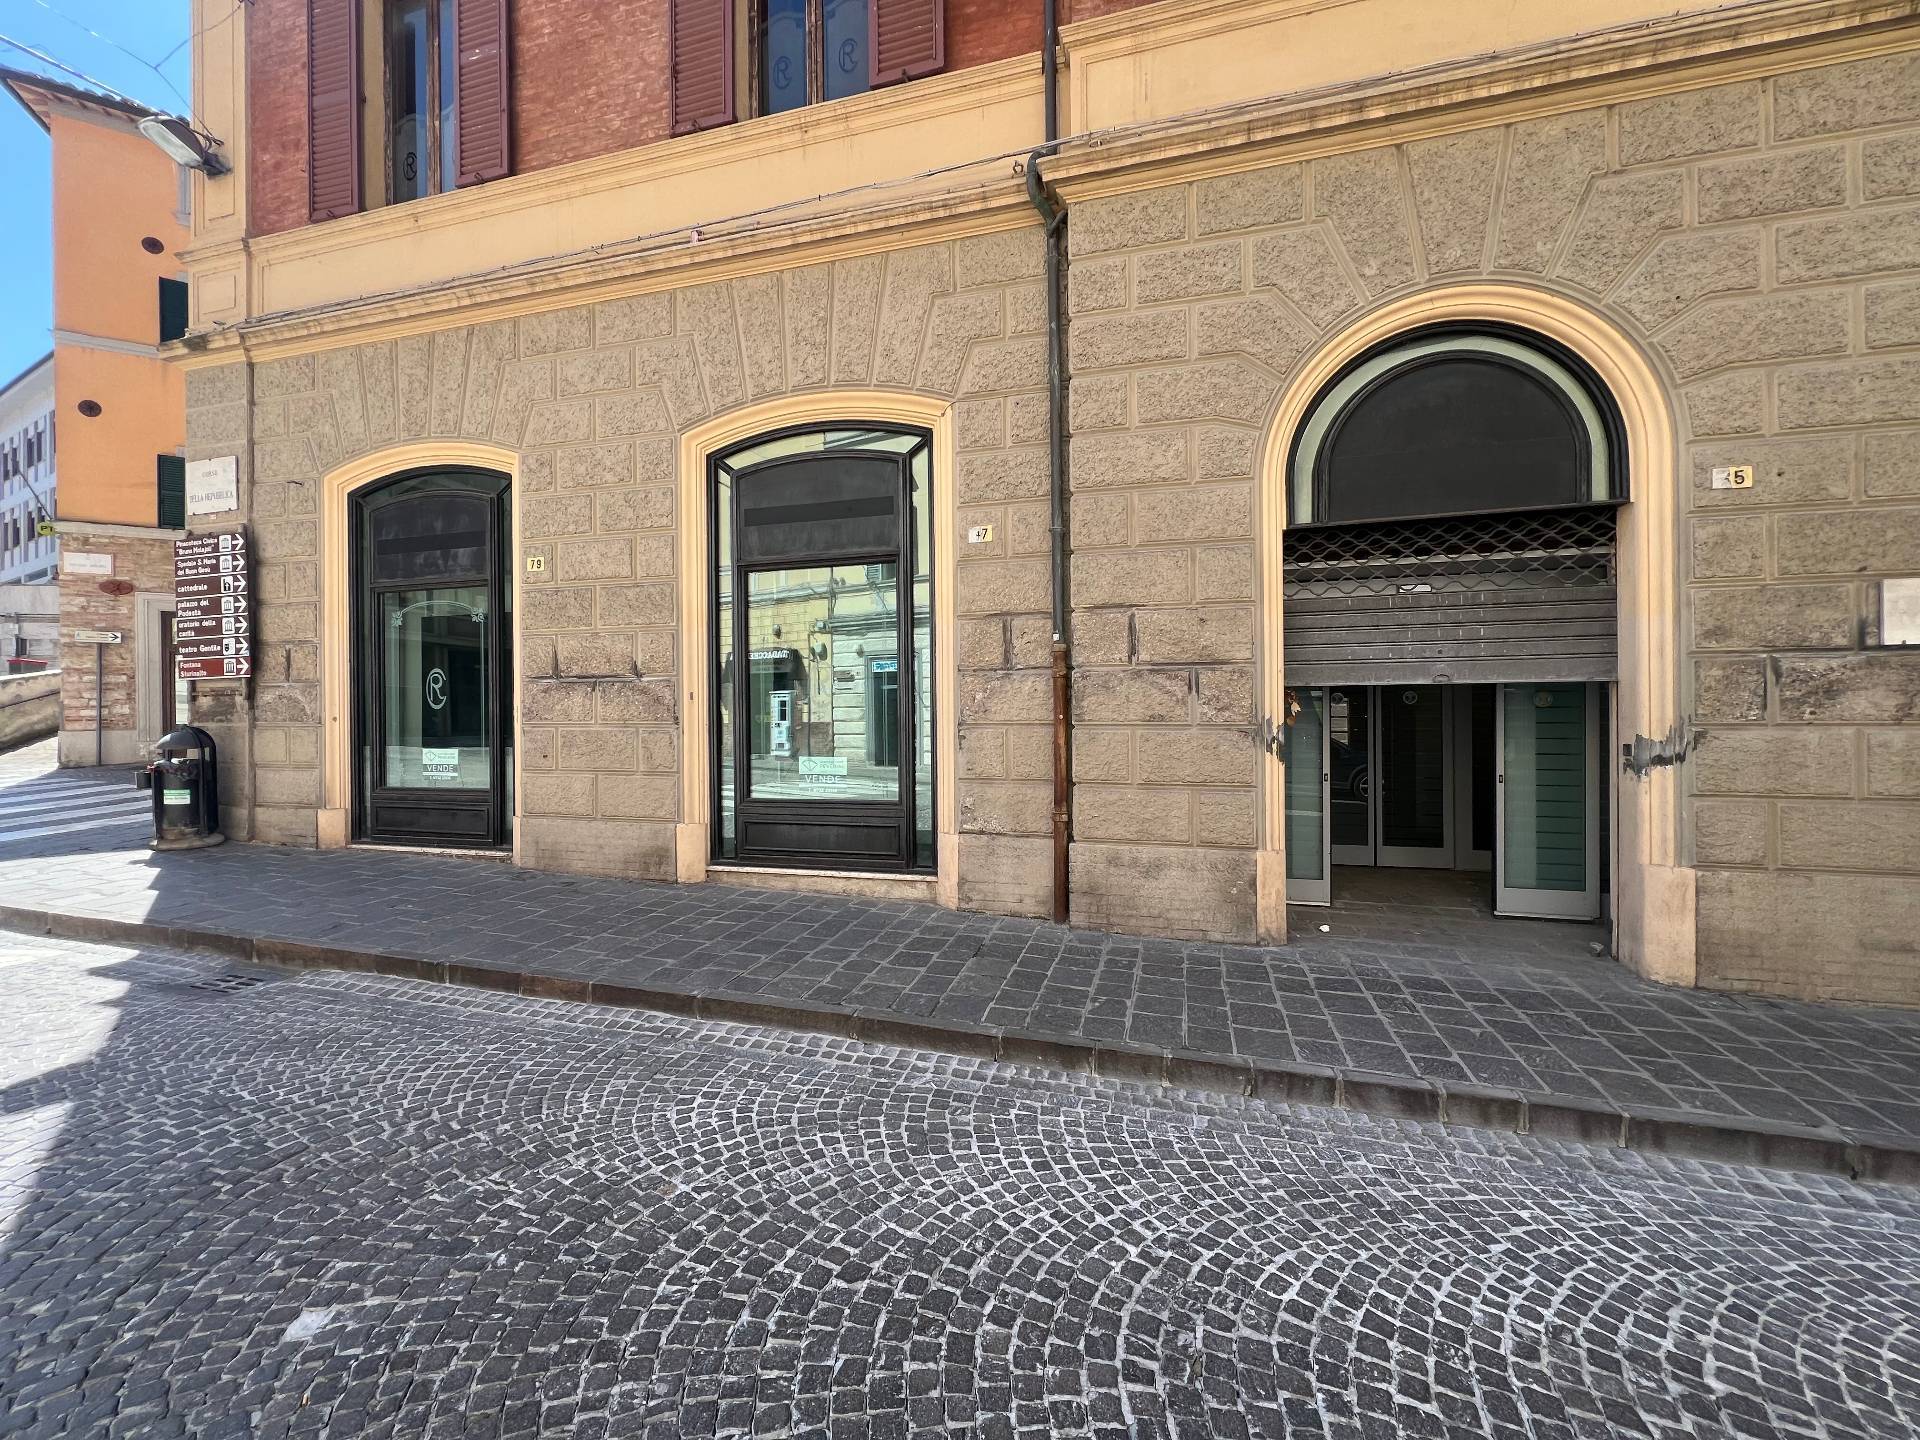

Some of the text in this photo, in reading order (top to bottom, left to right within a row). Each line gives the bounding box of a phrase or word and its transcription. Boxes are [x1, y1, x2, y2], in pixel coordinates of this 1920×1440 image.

[530, 559, 542, 570] 79
[177, 583, 208, 593] cattedrale
[177, 599, 210, 610] palazzo del
[178, 619, 216, 628] oratorio della
[179, 644, 221, 654] teatro Gentile
[427, 764, 454, 773] VENDE
[805, 774, 842, 784] VENDE
